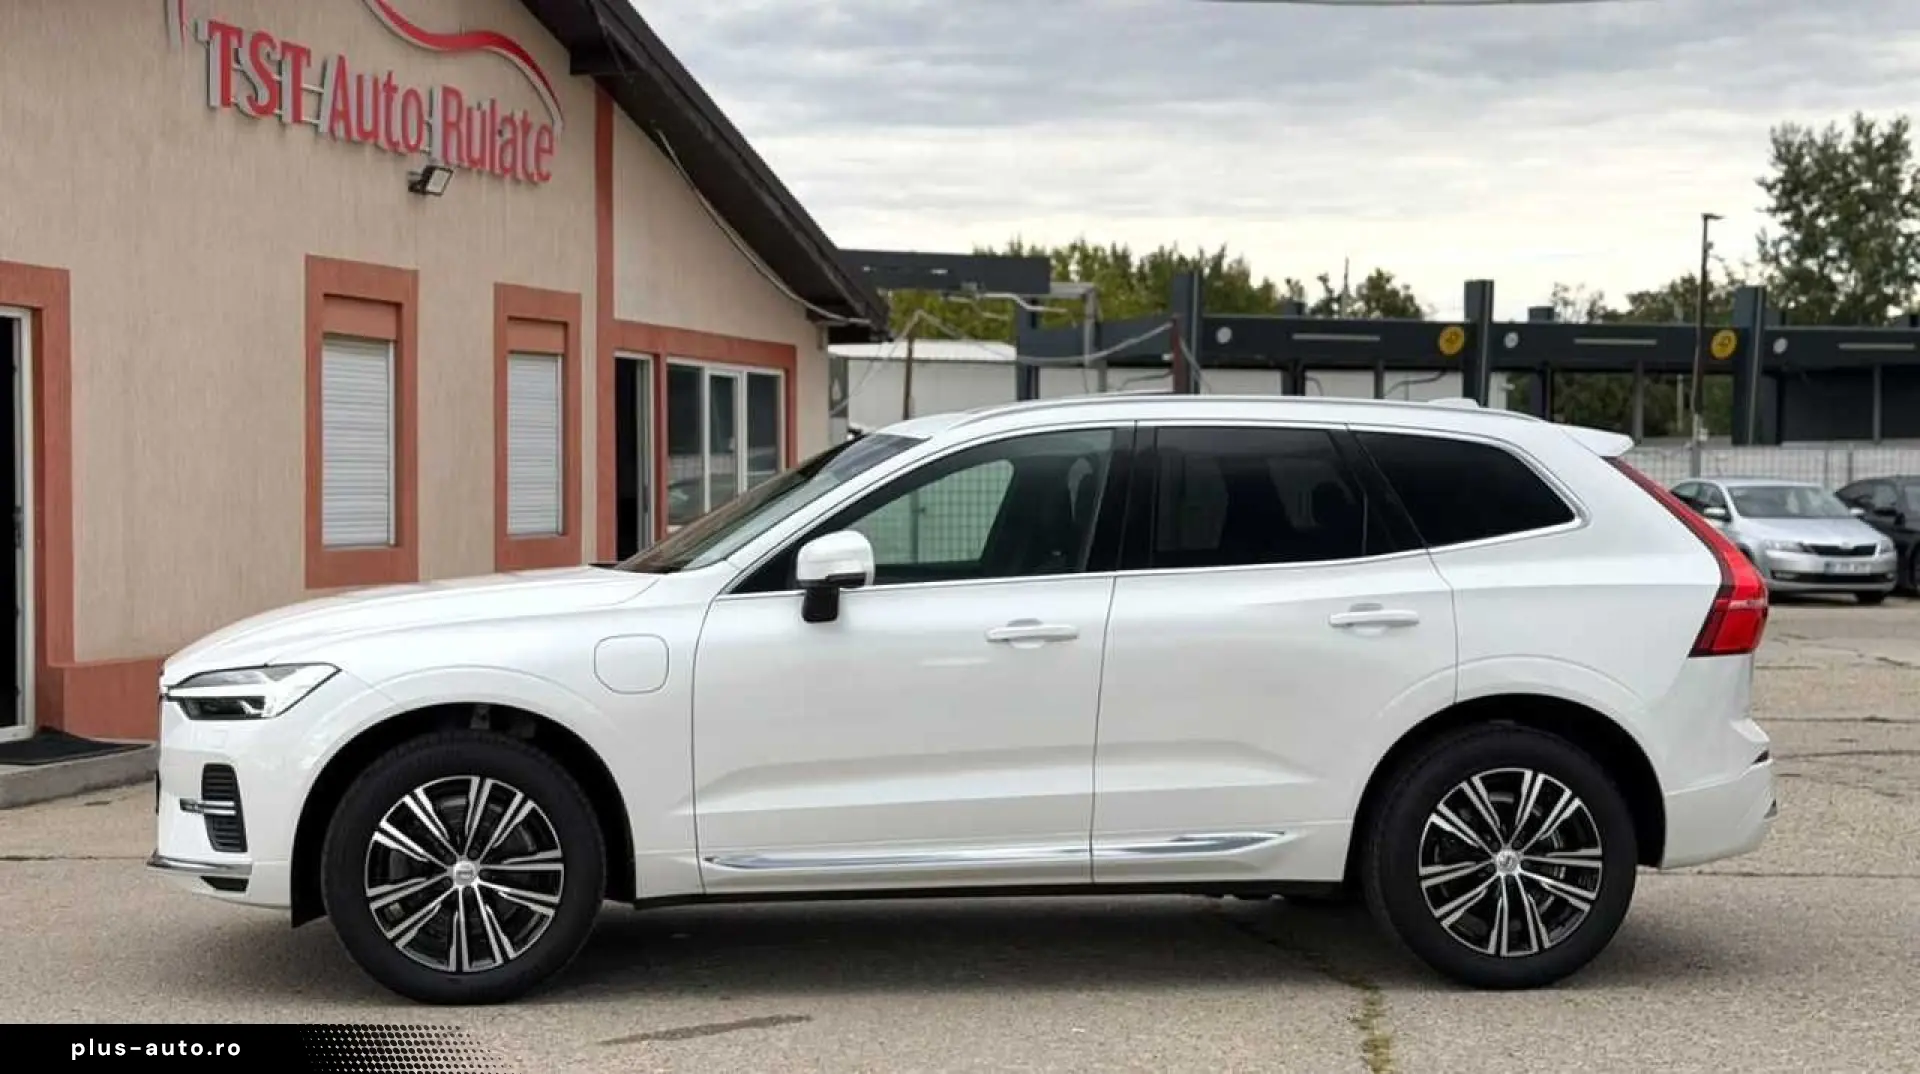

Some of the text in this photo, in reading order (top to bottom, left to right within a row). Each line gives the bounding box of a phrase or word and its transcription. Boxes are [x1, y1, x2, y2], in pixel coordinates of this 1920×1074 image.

[206, 20, 554, 183] TST Auto Rulate
